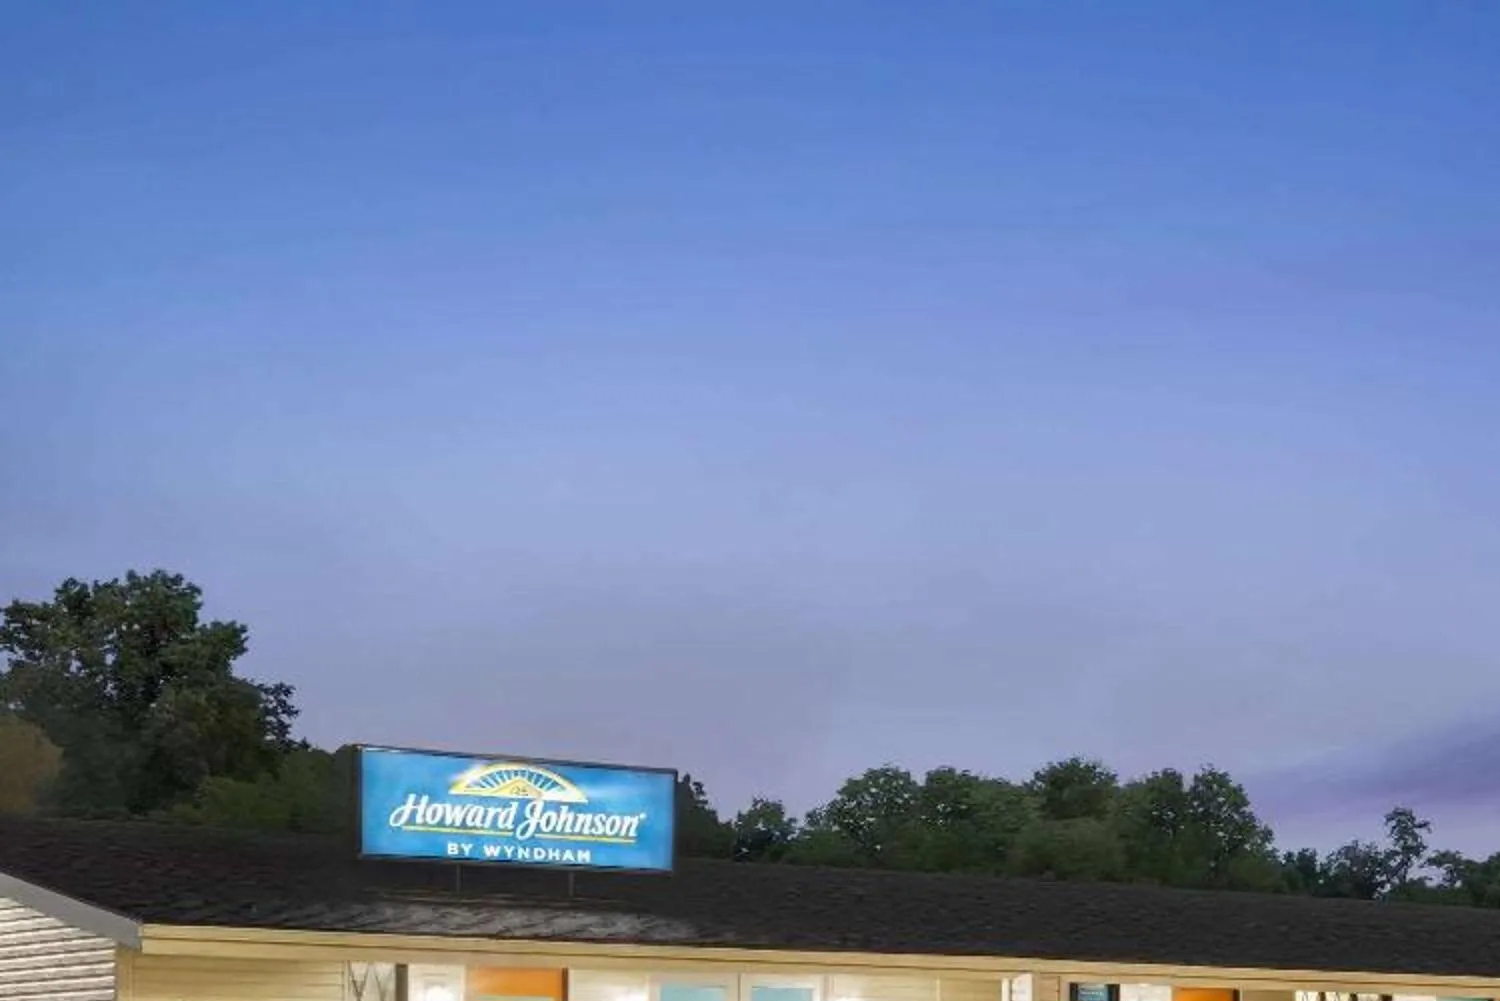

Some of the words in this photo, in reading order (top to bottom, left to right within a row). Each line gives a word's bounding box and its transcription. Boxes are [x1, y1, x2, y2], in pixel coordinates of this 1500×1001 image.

[389, 793, 518, 830] Howard
[516, 799, 639, 841] Johnson
[447, 843, 474, 856] BY
[483, 844, 592, 863] WYNDHAM
